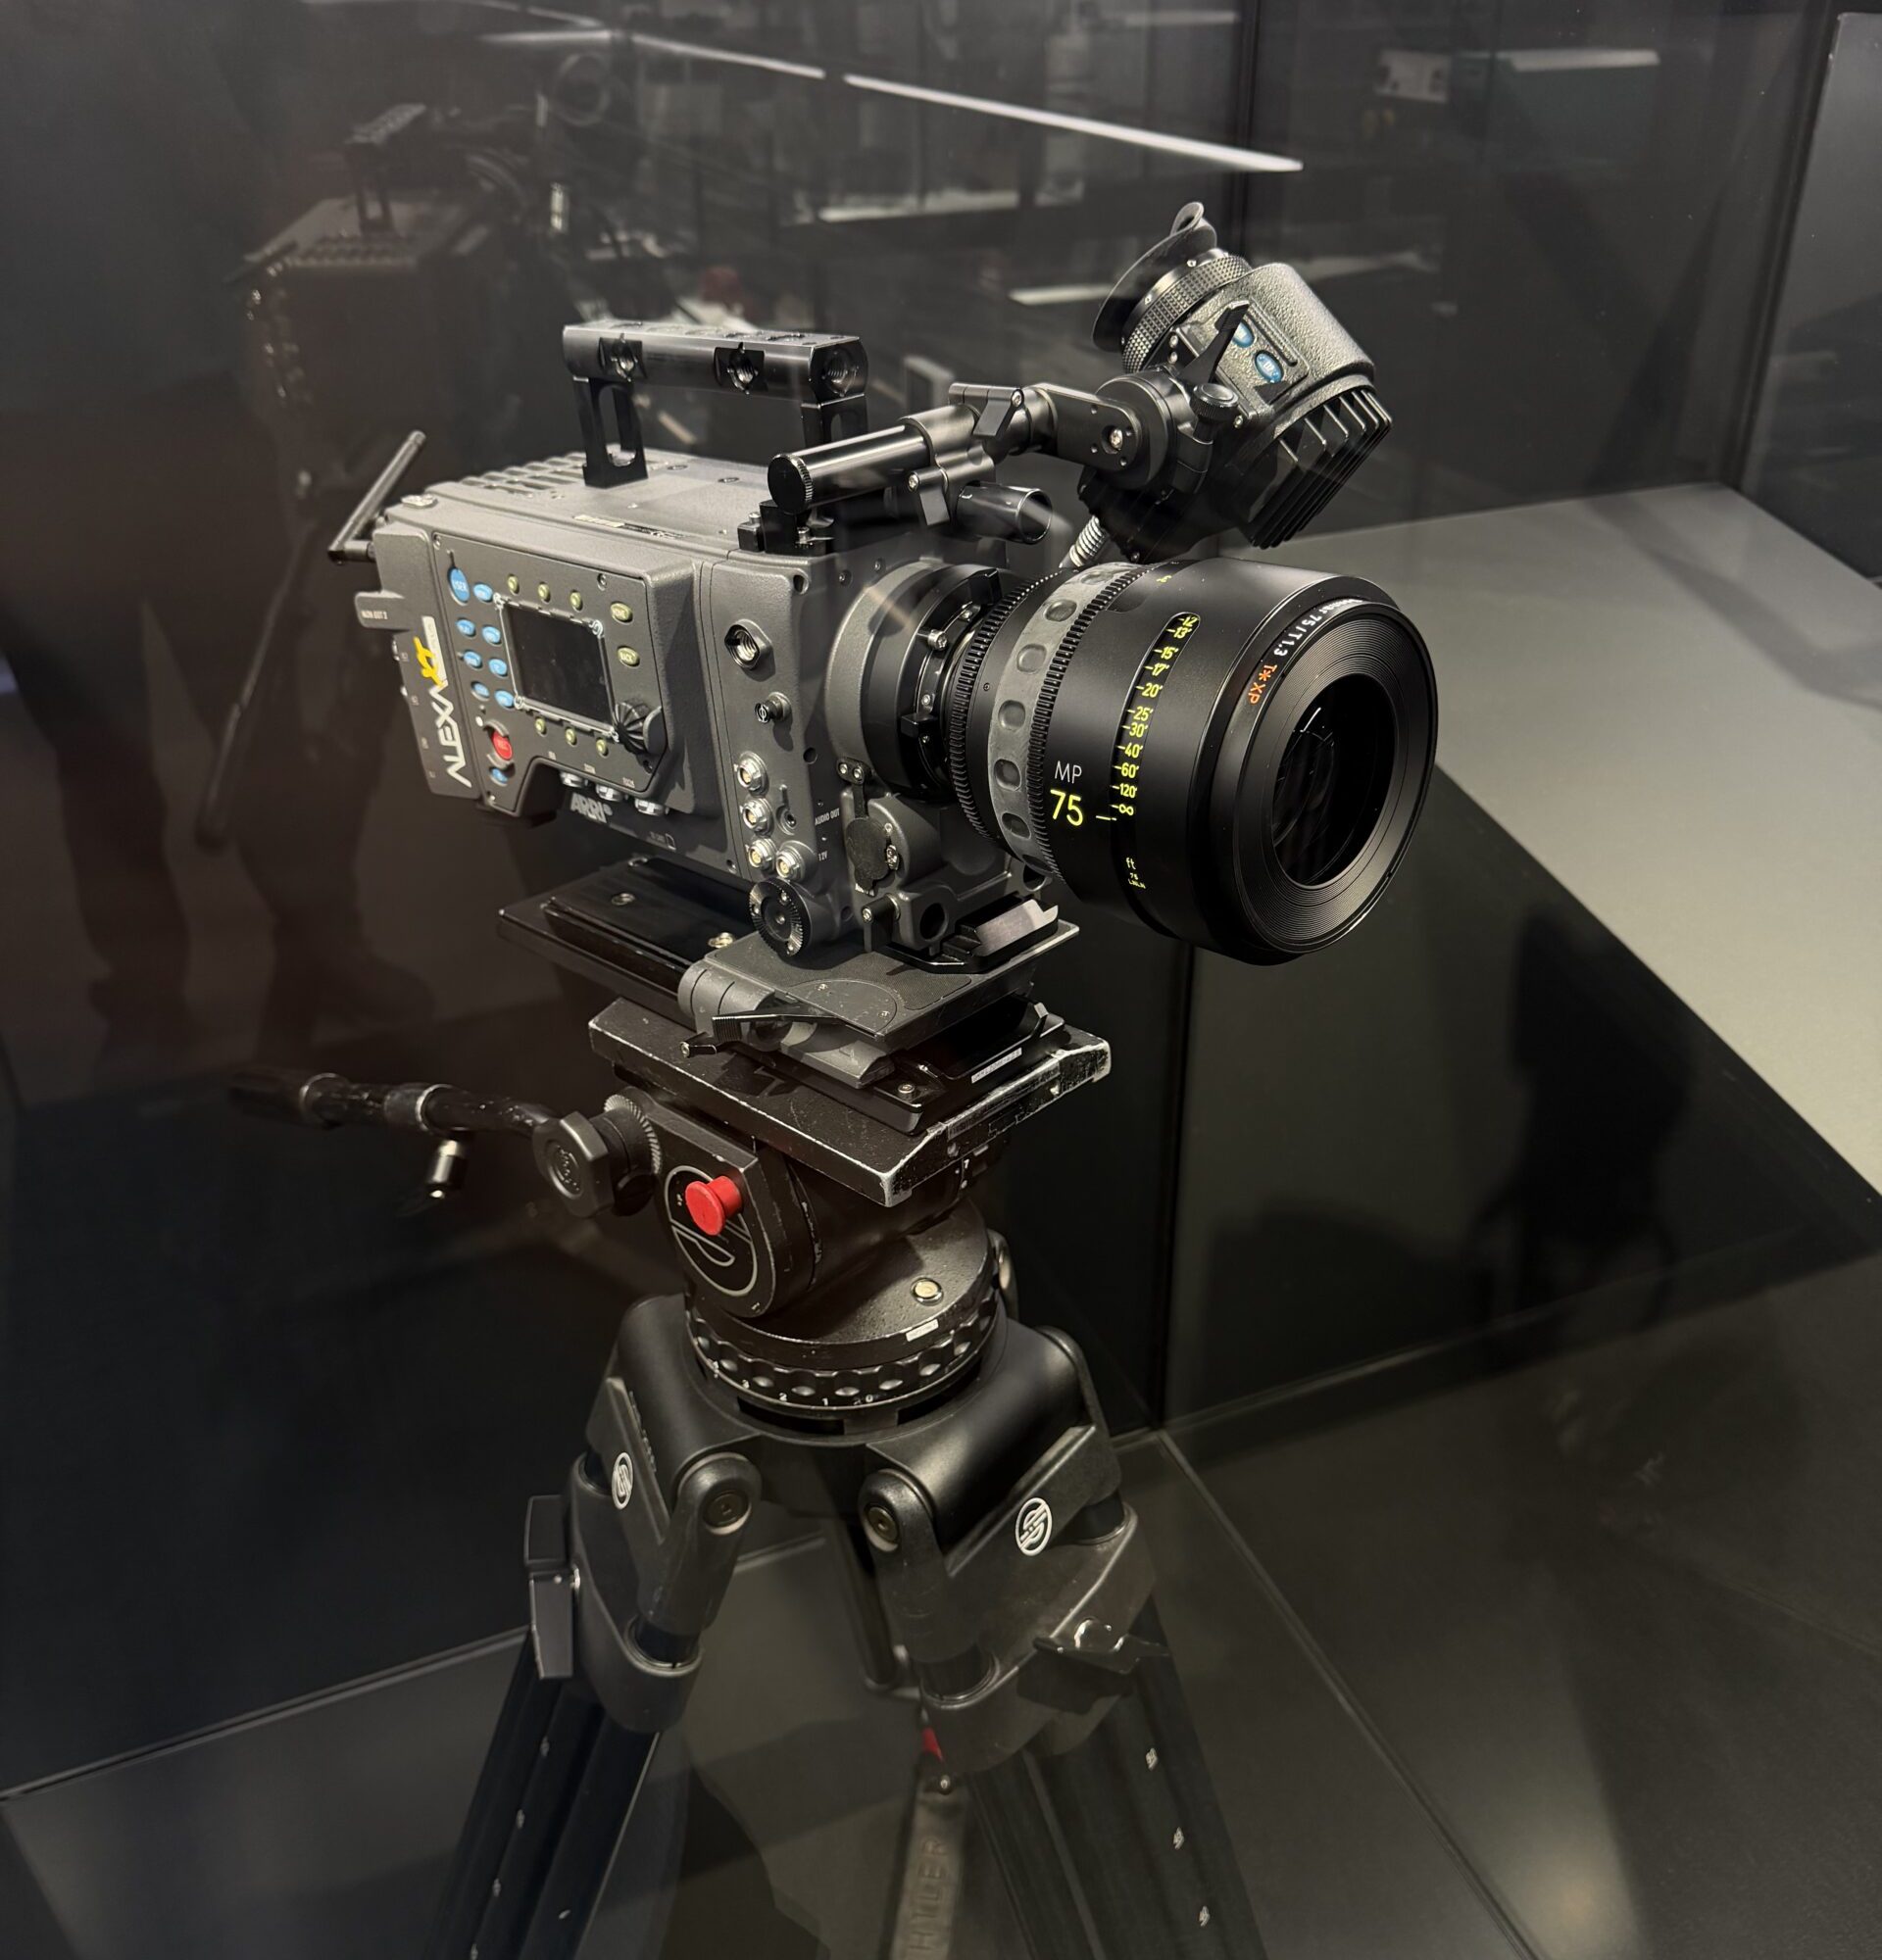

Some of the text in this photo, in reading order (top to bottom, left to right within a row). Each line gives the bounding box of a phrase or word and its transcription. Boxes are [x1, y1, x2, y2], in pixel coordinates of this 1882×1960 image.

[1141, 682, 1164, 698] 20'
[1133, 706, 1154, 721] 25'
[429, 680, 472, 788] ALEXA
[1128, 722, 1149, 738] 30'
[1124, 743, 1144, 759] 40'
[1054, 760, 1083, 784] MP
[1120, 761, 1140, 779] 60'
[1118, 783, 1138, 799] 120'
[1050, 789, 1084, 827] 75
[815, 808, 840, 826] AUDIO OUT
